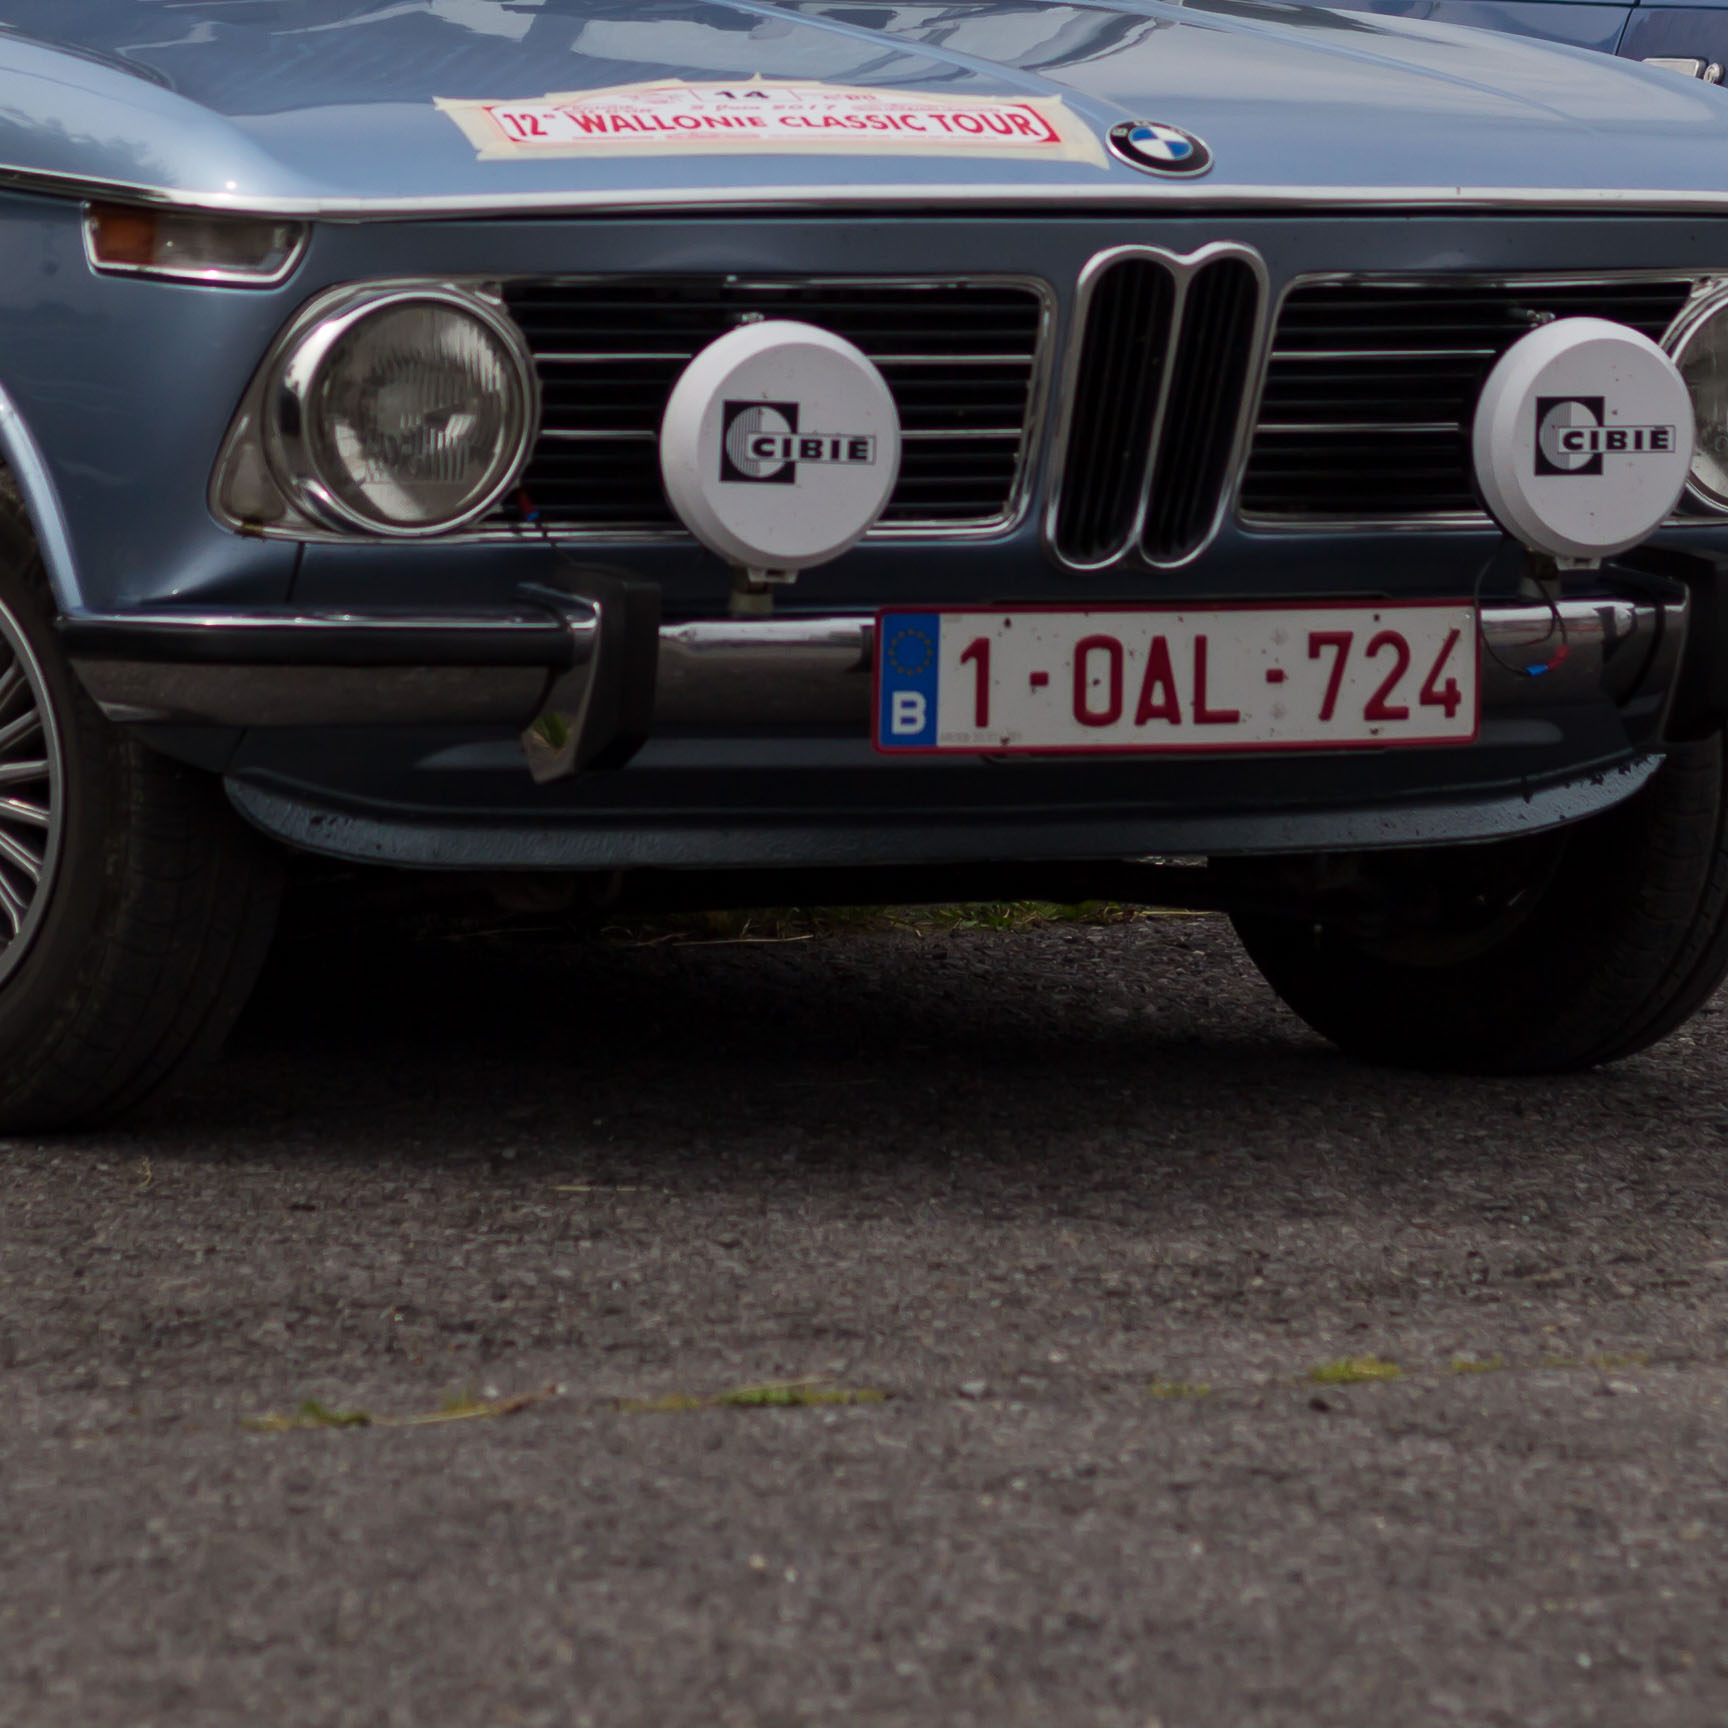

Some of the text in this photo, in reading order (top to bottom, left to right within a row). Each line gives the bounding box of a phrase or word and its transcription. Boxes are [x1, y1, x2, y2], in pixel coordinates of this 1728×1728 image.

[563, 112, 768, 135] WALLONIE
[778, 114, 928, 132] CLASSIC
[930, 113, 1041, 138] TOUR
[960, 630, 1463, 730] 1-OAL-724
[890, 690, 927, 735] B
